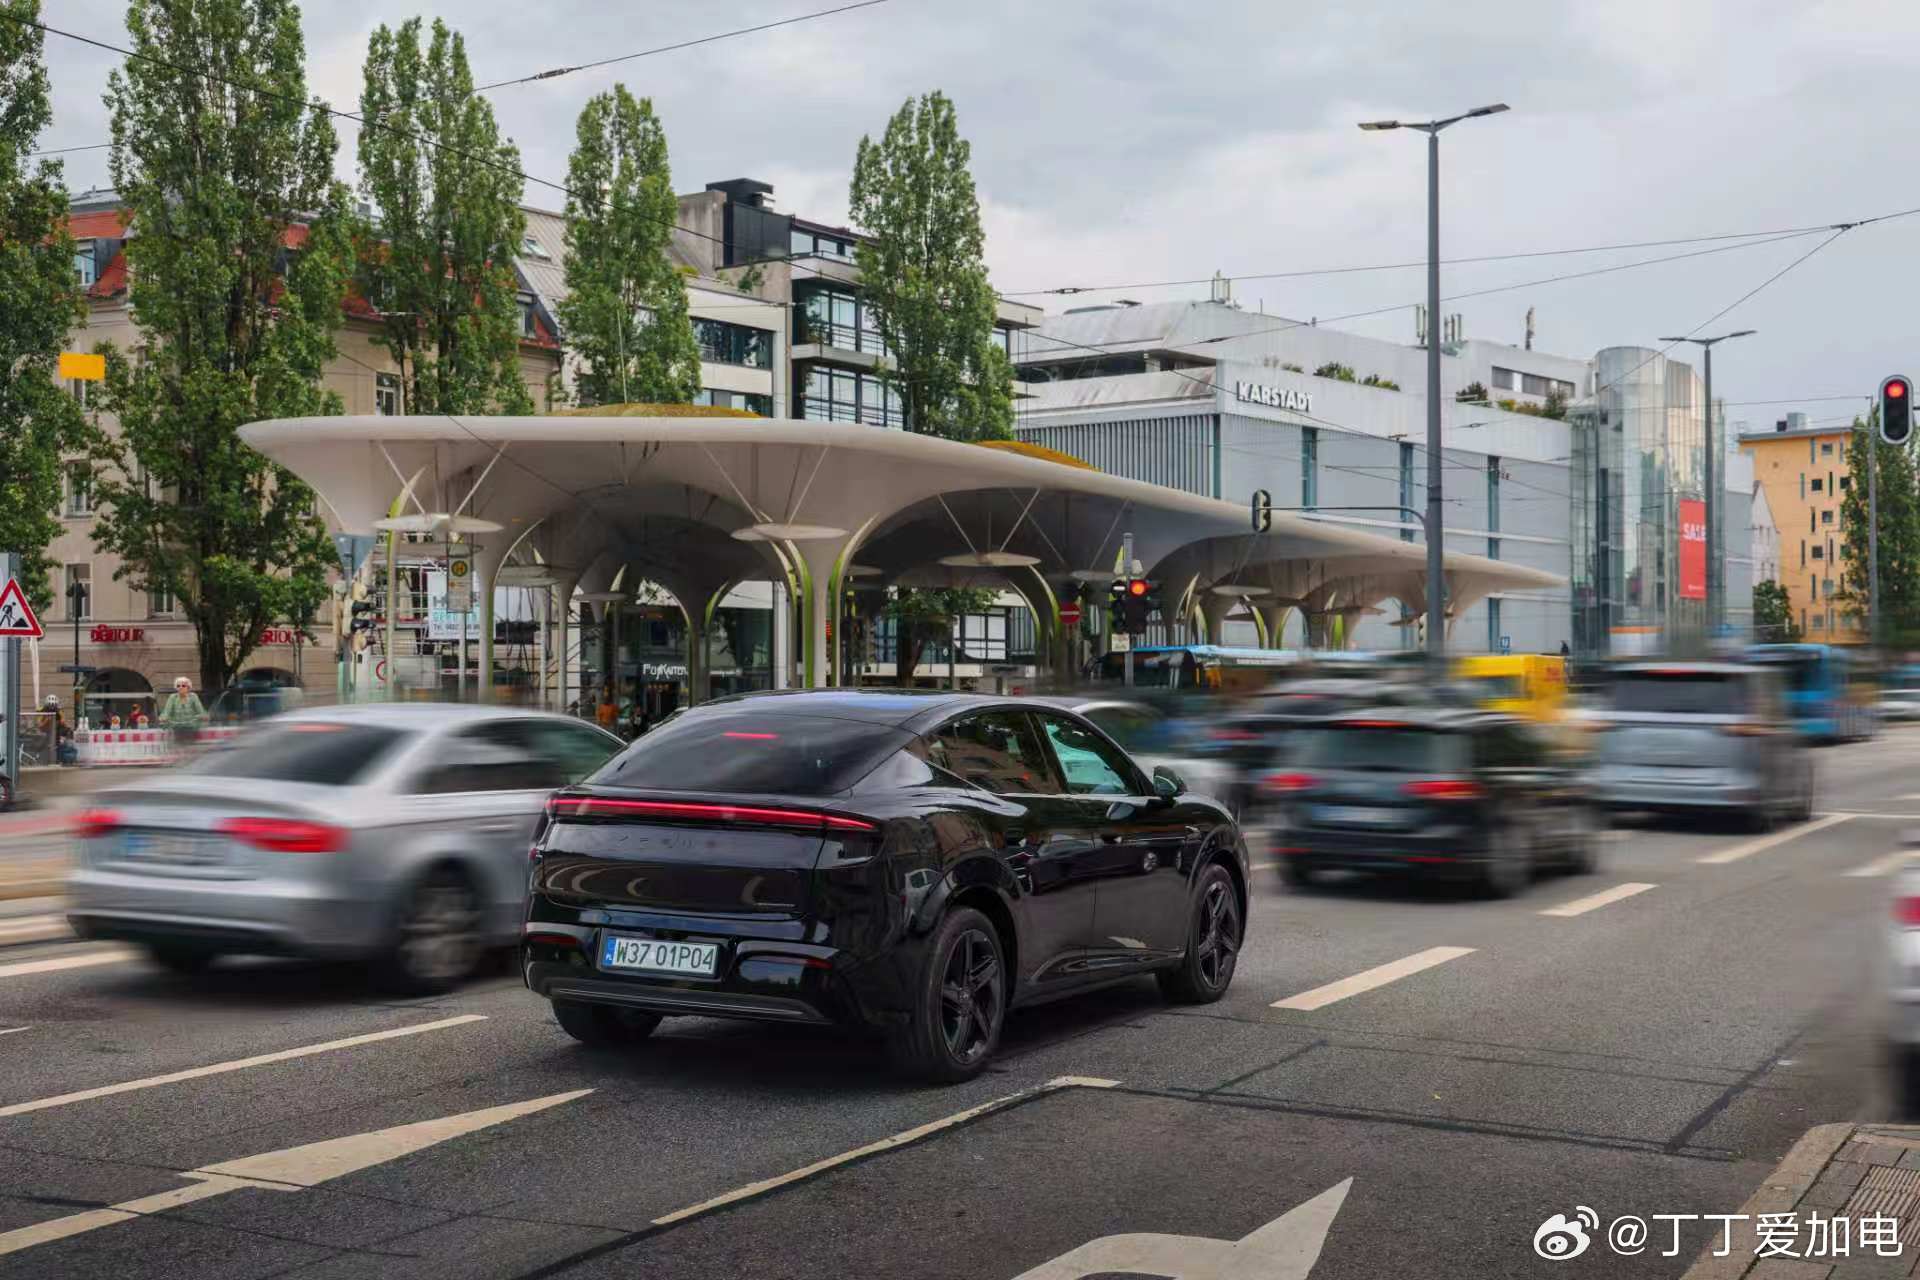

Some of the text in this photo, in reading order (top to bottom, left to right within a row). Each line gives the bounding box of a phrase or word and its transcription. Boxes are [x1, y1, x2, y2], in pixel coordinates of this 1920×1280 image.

[1237, 381, 1312, 412] KARSTADT
[616, 939, 715, 970] W37 01P04
